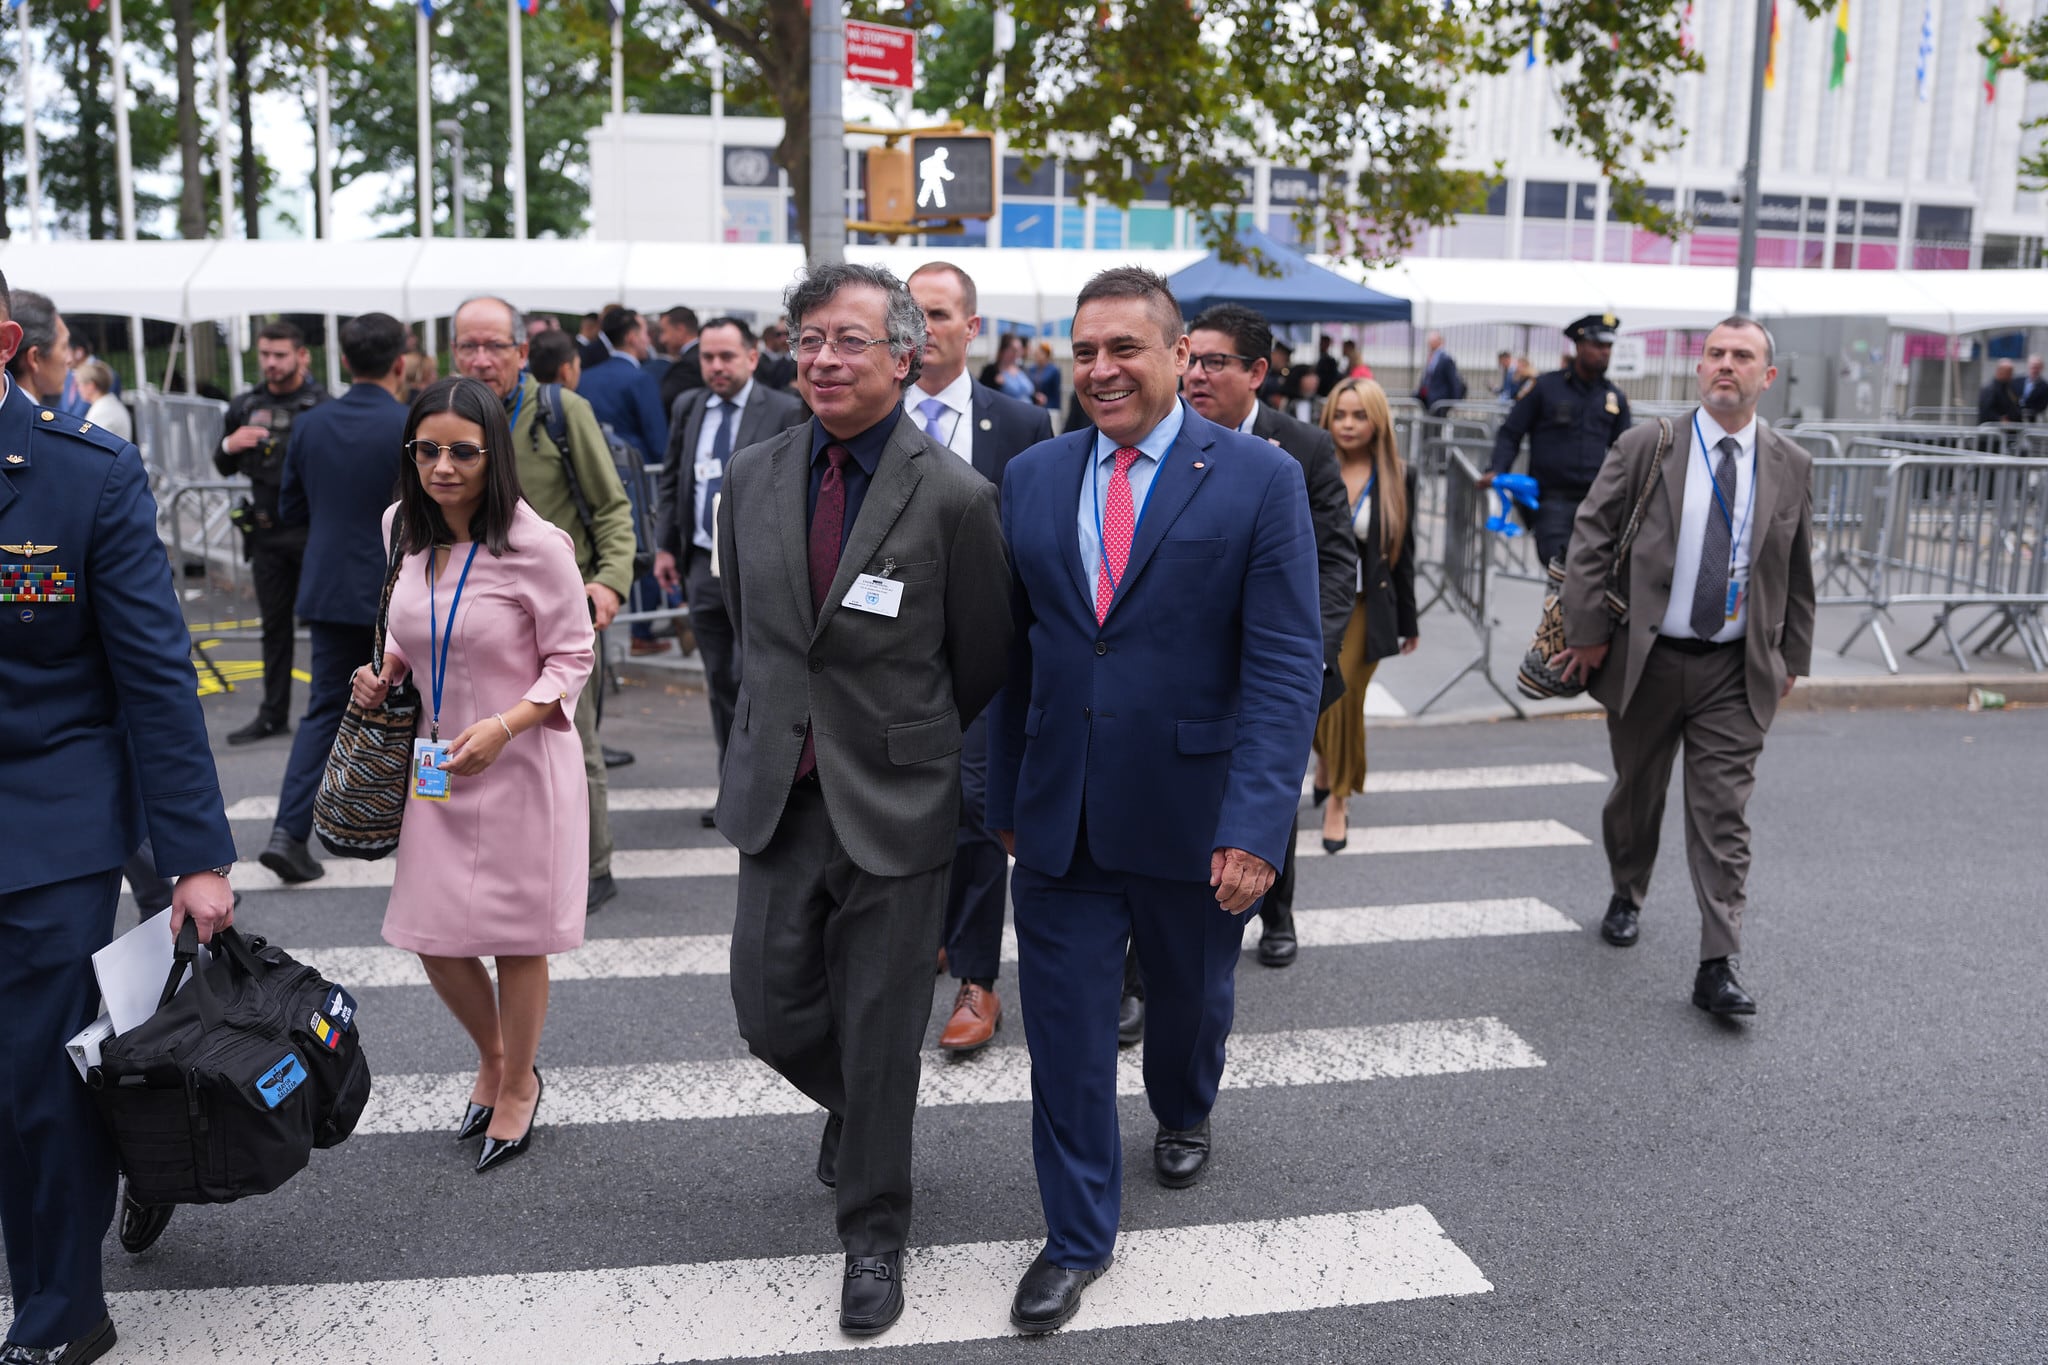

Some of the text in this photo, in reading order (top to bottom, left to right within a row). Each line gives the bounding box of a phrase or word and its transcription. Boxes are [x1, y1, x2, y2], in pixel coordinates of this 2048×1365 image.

[849, 29, 860, 41] NO
[276, 1079, 291, 1091] MAYOR
[277, 1081, 297, 1099] SALAZAR
